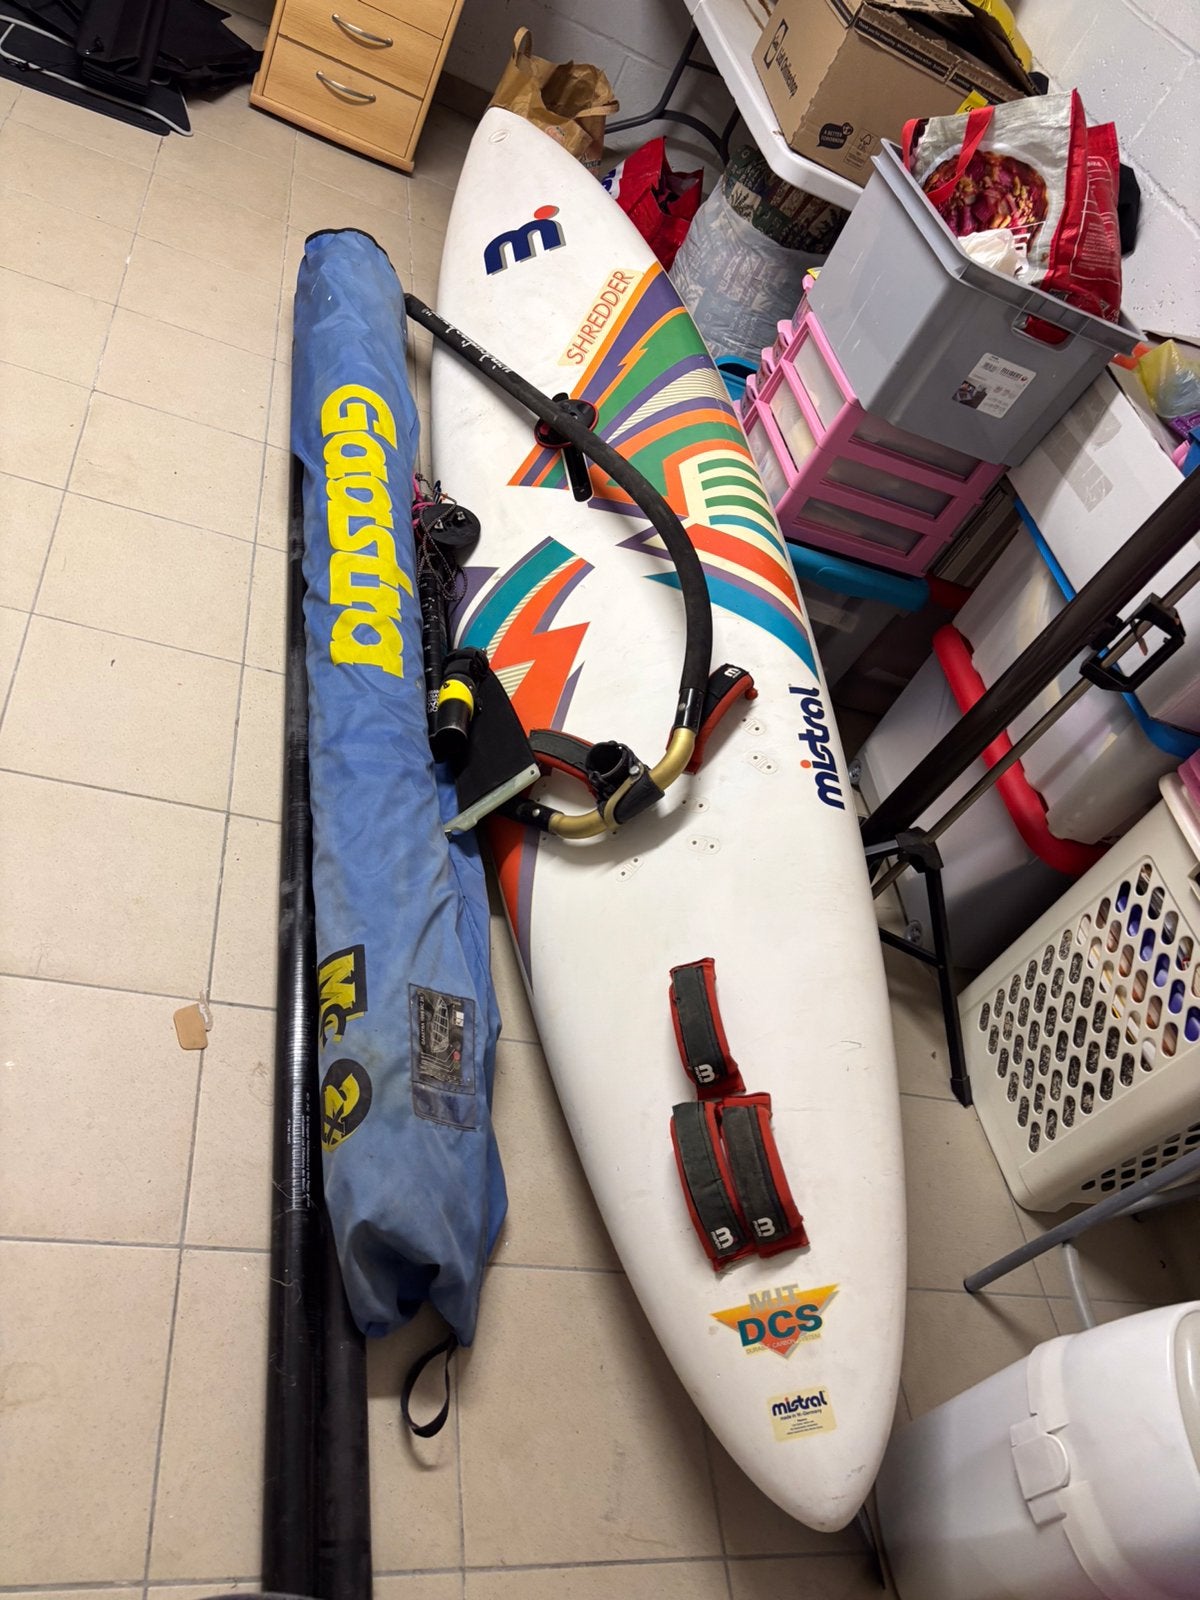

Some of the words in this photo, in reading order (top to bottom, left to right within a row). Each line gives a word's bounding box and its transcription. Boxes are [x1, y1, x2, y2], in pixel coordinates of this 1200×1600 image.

[567, 271, 635, 365] SHREDDER
[320, 384, 414, 678] Gaastra
[788, 686, 846, 810] mistral
[748, 1283, 800, 1312] MIT
[737, 1303, 823, 1347] DCS
[772, 1339, 796, 1348] CARBON
[772, 1390, 828, 1416] mistral
